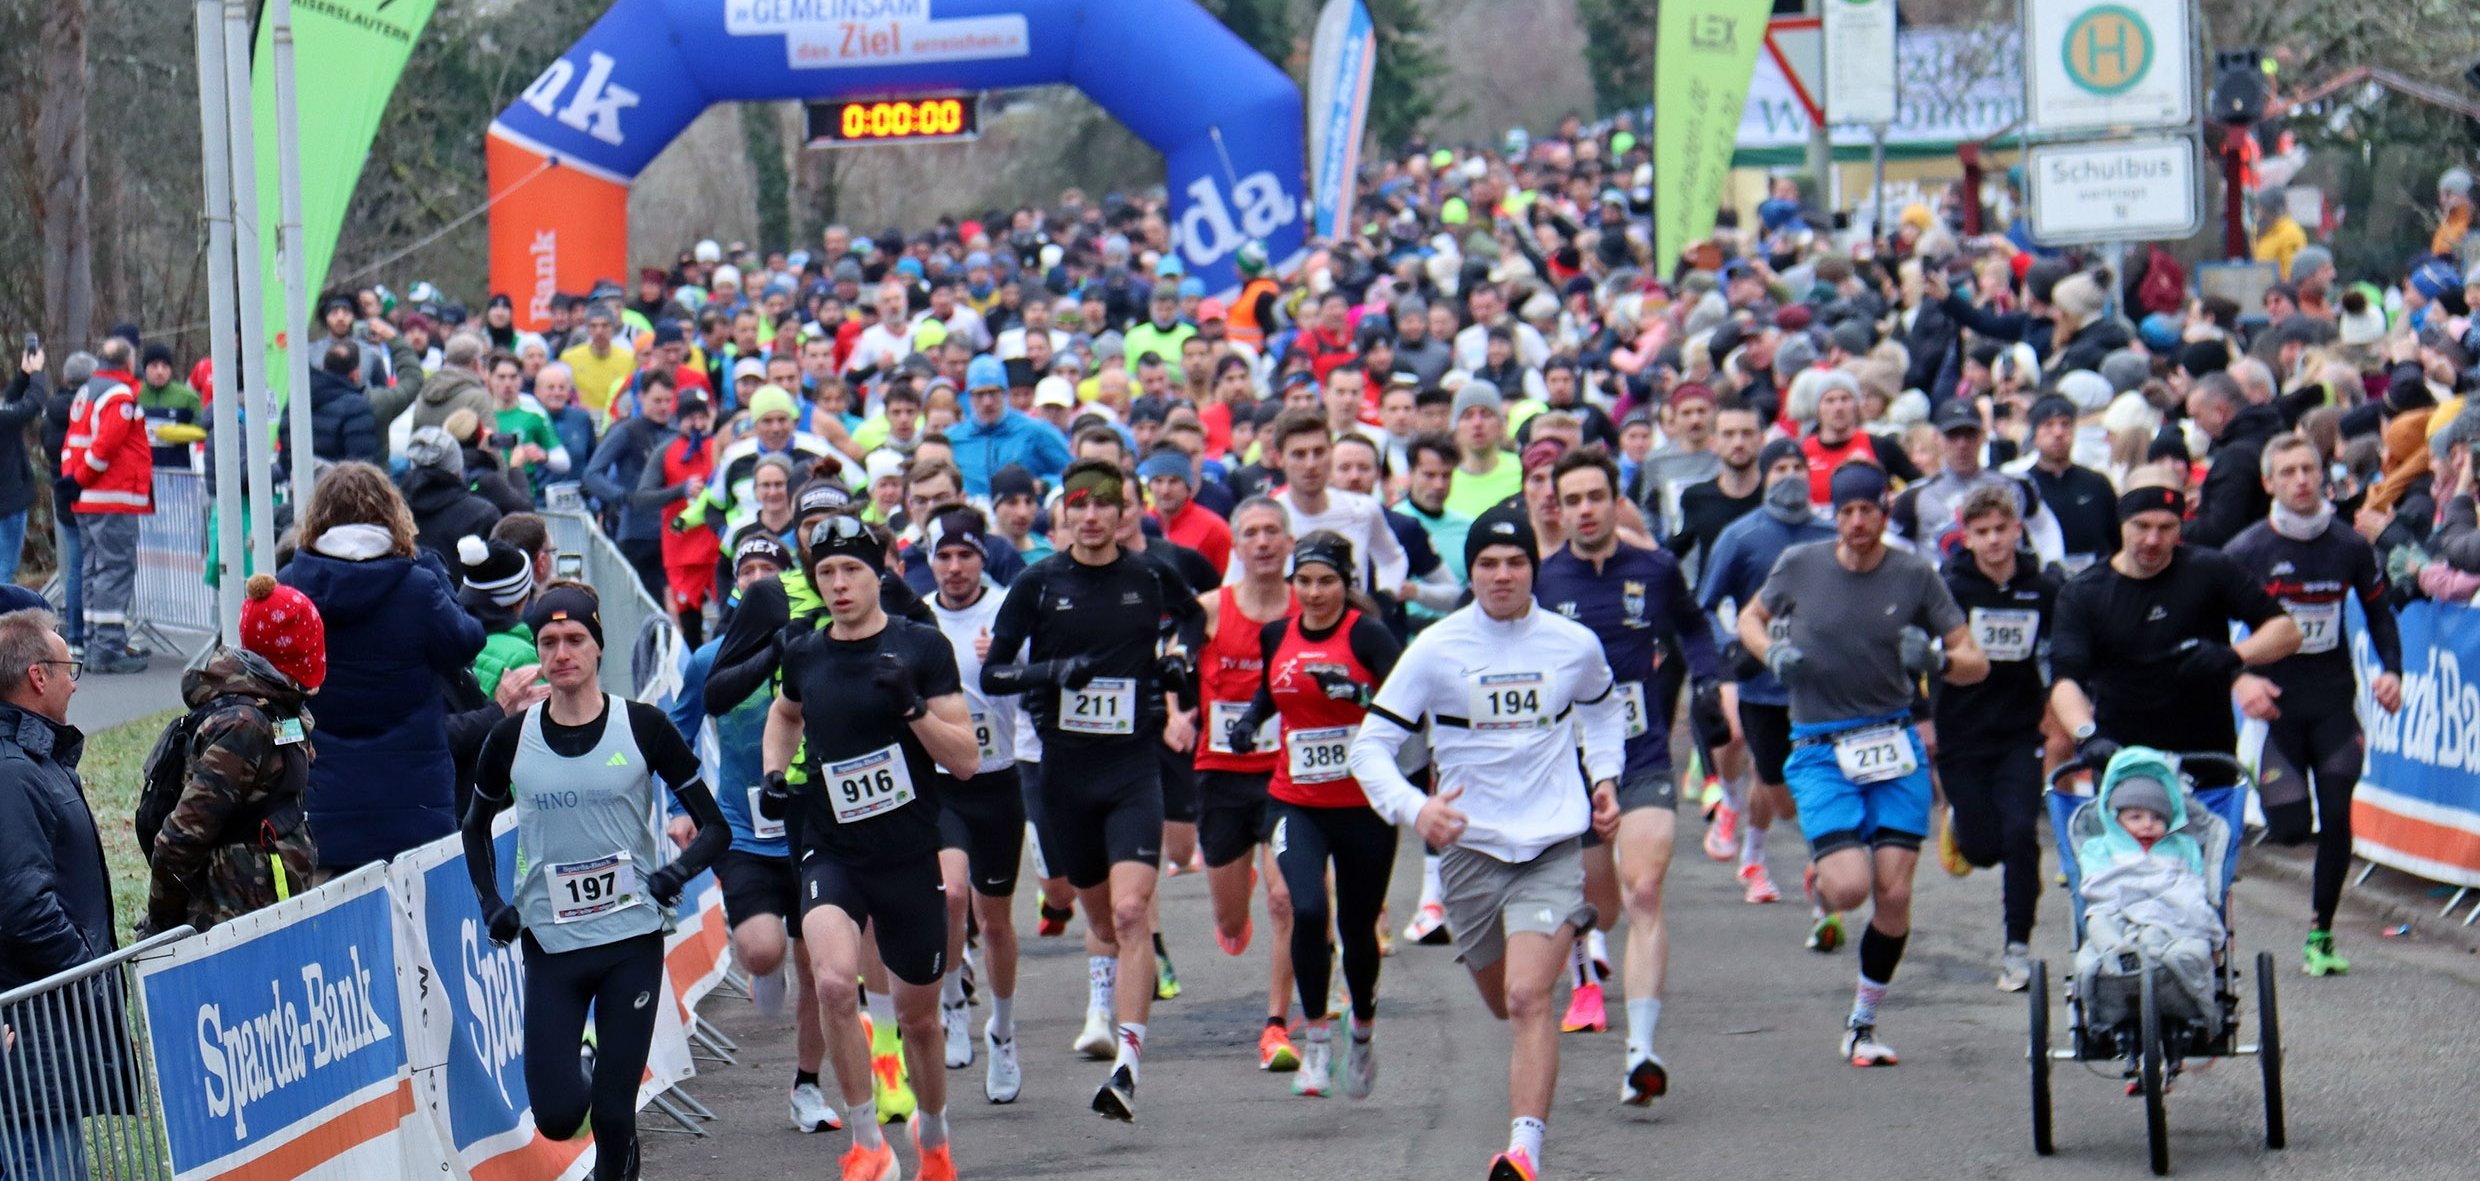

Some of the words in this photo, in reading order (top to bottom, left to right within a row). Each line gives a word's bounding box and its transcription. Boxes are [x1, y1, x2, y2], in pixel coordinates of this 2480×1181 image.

[837, 22, 901, 58] Ziel
[842, 100, 962, 138] 0:00:00
[2052, 156, 2173, 184] Schulbus
[529, 228, 556, 324] Bank
[1983, 626, 2023, 645] 395
[1075, 695, 1118, 716] 211
[1488, 690, 1539, 715] 194
[1625, 701, 1638, 722] 3
[1302, 744, 1345, 768] 388
[1855, 744, 1898, 768] 273
[842, 769, 894, 803] 916
[535, 791, 577, 810] HNO
[566, 871, 615, 903] 197
[197, 946, 391, 1141] Sparda-Bank
